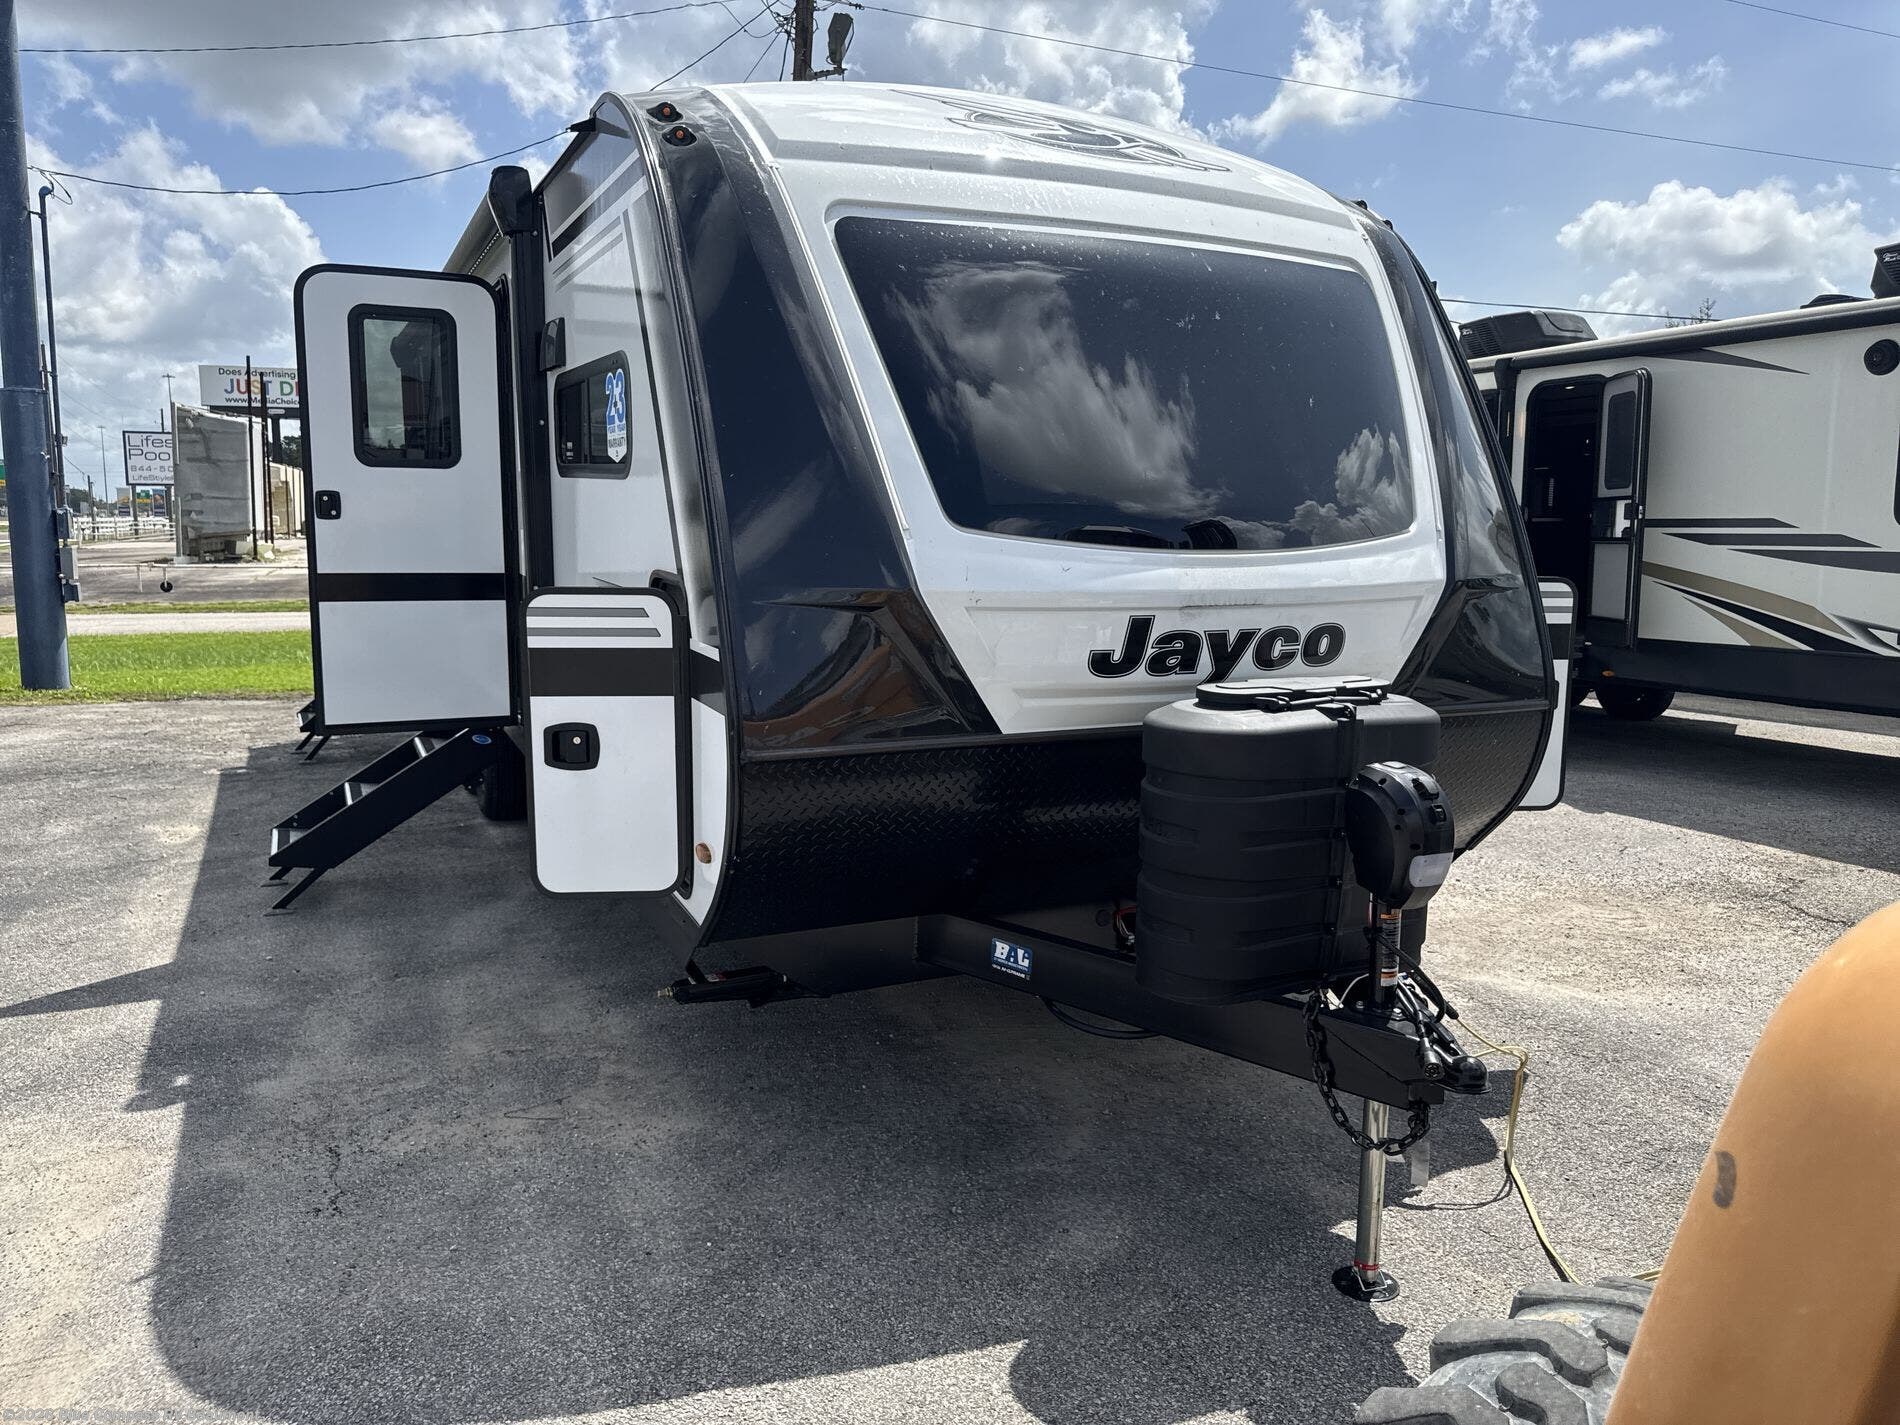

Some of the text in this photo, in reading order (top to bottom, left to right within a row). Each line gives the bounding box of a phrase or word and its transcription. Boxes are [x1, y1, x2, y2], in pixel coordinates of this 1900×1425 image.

[218, 367, 242, 375] Does
[224, 378, 272, 395] JUST
[1087, 614, 1346, 686] Jayco
